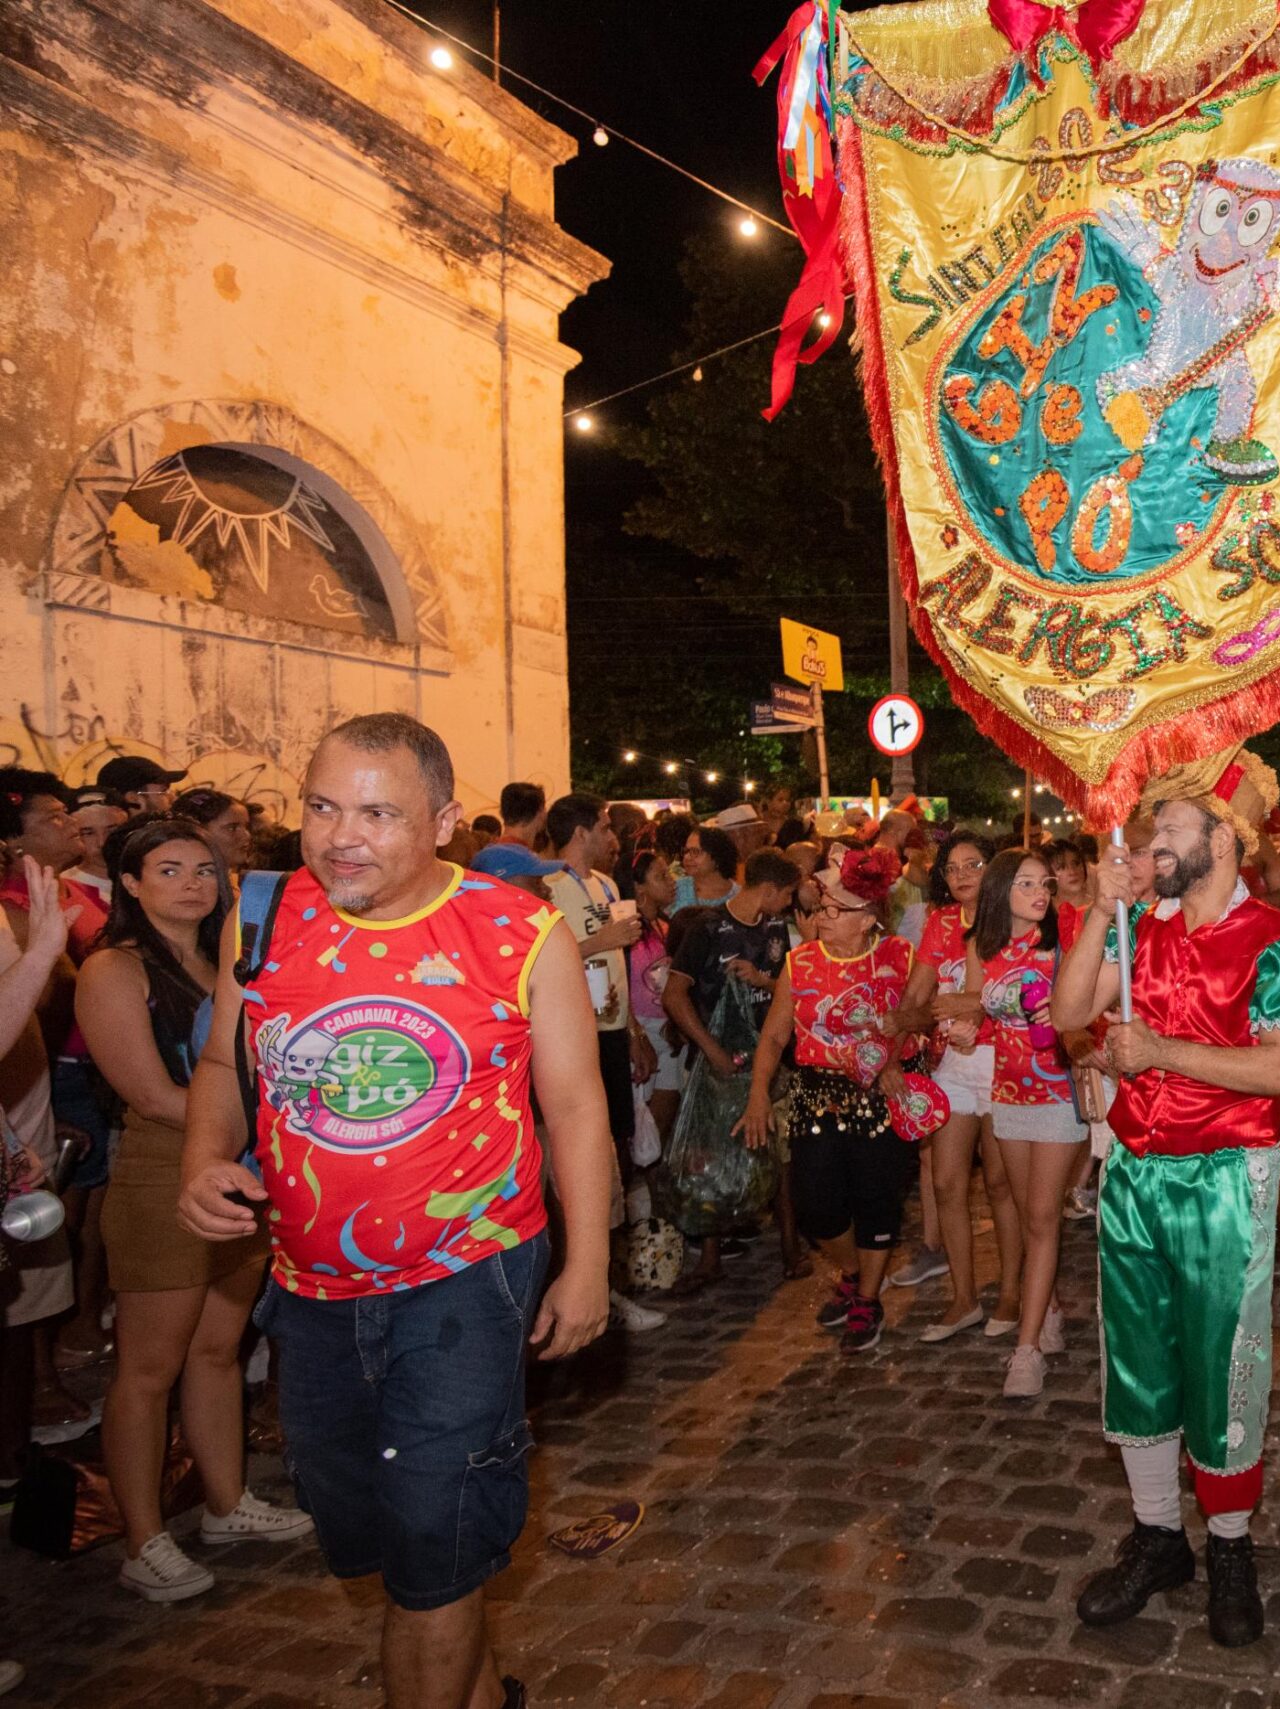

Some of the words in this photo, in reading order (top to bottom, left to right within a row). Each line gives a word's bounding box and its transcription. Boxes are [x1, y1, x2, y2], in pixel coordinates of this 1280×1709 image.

[1028, 107, 1195, 227] 2023
[886, 193, 1047, 350] SINTEAL
[323, 1008, 398, 1034] CARNAVAL
[398, 1012, 436, 1040] 2023
[328, 1035, 409, 1074] giz
[347, 1078, 418, 1112] pó
[322, 1117, 377, 1140] ALERGIA
